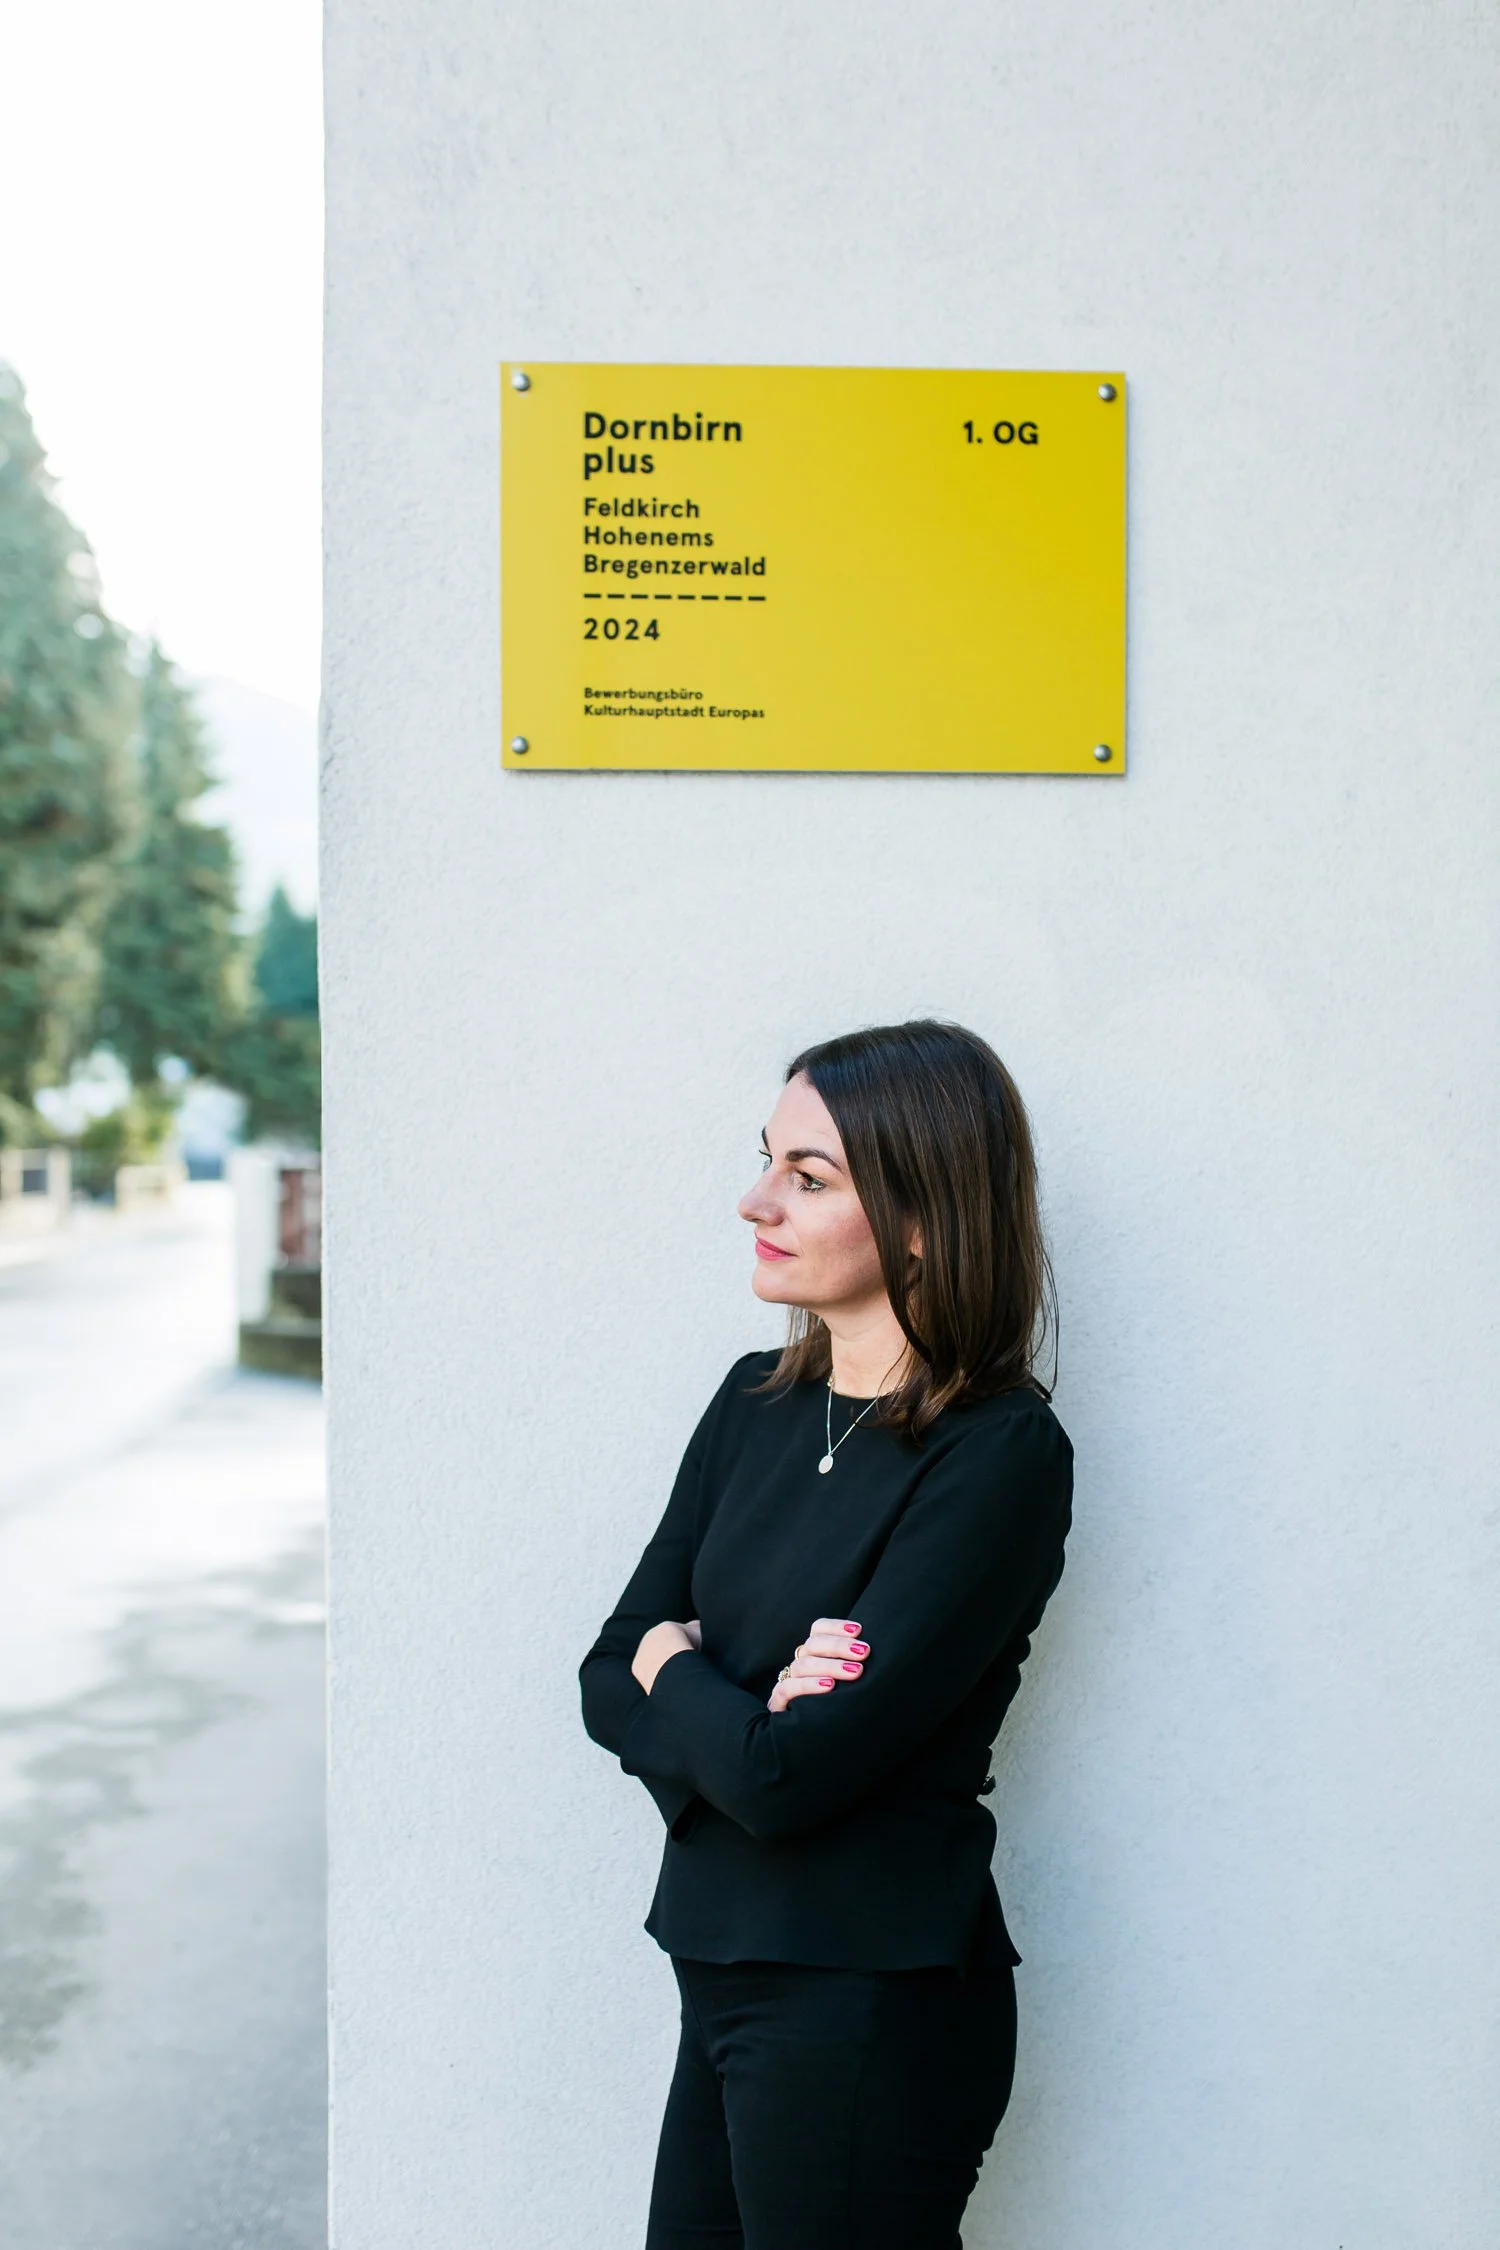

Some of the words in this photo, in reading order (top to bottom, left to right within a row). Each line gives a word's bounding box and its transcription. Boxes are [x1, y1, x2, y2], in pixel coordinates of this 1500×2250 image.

[584, 411, 742, 442] Dornbirn
[963, 420, 984, 444] 1.
[993, 421, 1039, 446] OG
[584, 445, 654, 481] plus
[584, 497, 699, 519] Feldkirch
[584, 525, 714, 547] Hohenems
[584, 553, 766, 579] Bregenzerwald
[583, 617, 660, 641] 2024
[584, 687, 703, 702] Bewerbungsbüro
[584, 704, 704, 719] Kulturhauptstadt
[709, 706, 765, 720] Europas
